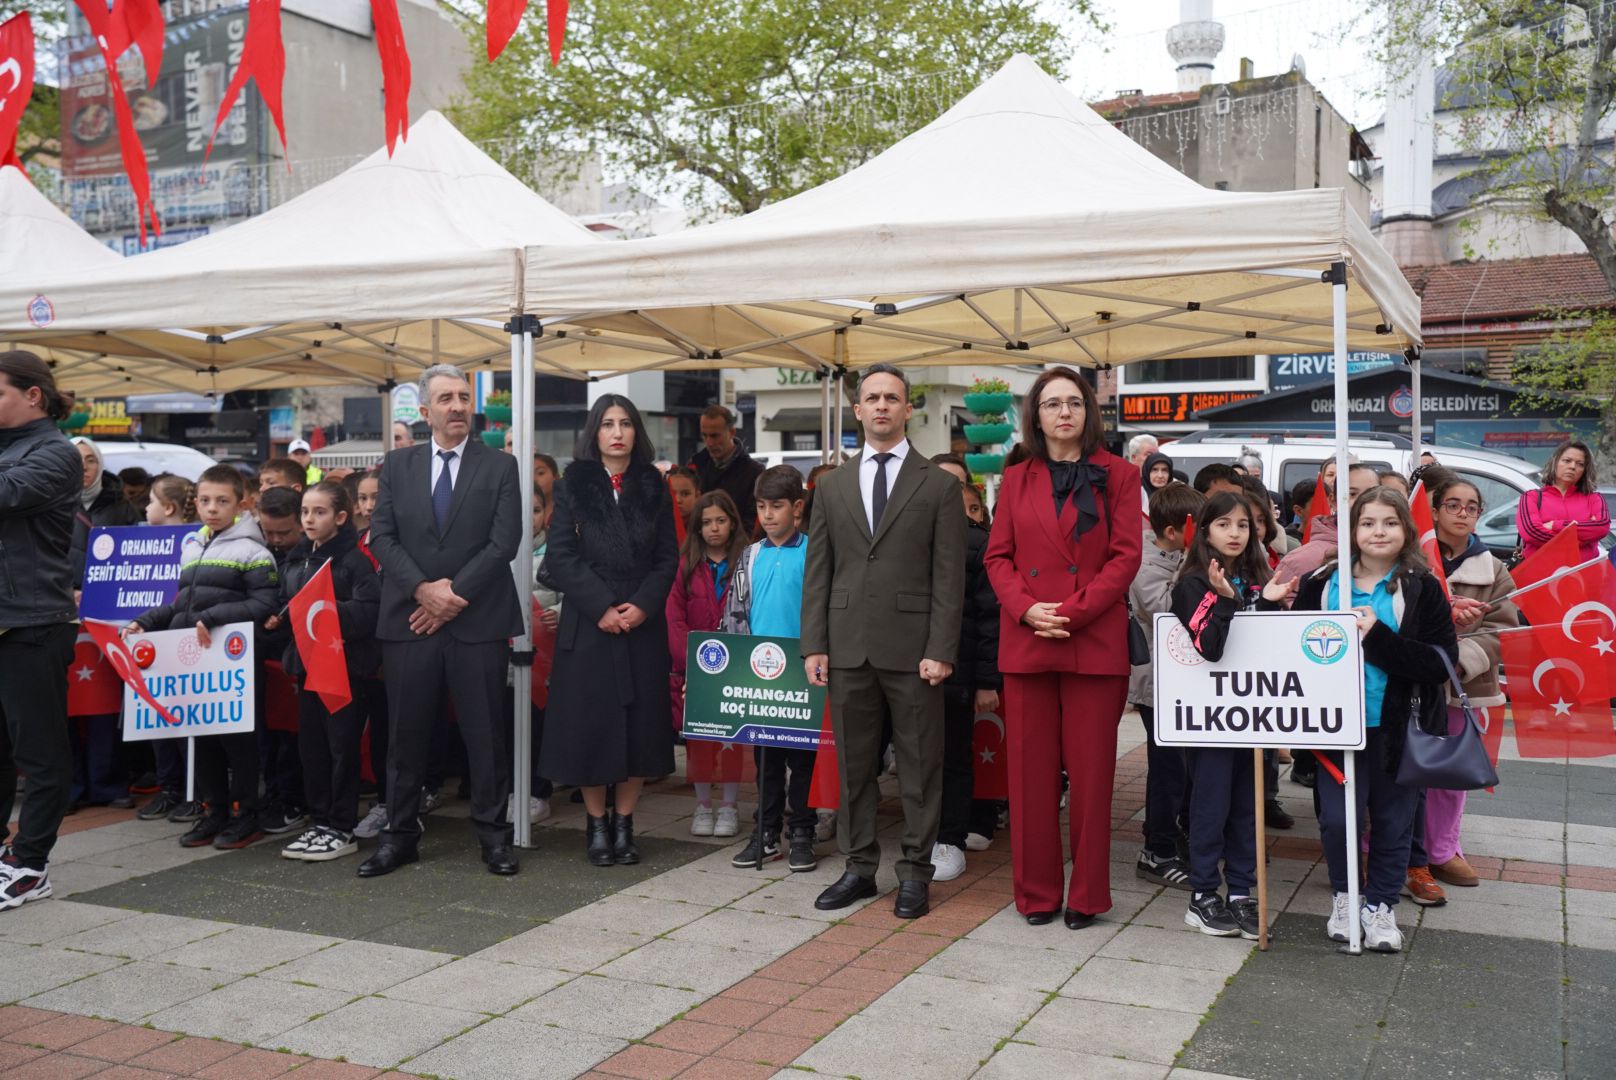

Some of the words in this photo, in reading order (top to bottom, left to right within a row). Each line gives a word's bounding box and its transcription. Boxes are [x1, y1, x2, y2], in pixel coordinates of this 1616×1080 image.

[184, 51, 203, 151] NEVER
[1277, 353, 1335, 375] ZİRVE
[1347, 352, 1391, 362] LETİŞİM
[1311, 395, 1385, 413] ORHNGAZİ
[1421, 394, 1500, 412] BELEDİYESİ
[120, 535, 175, 556] ORHANGAZİ
[87, 561, 115, 583] ŞEHİT
[115, 560, 152, 582] BÜLENT
[116, 587, 163, 608] İLKOKULU
[722, 685, 809, 704] ORHANGAZİ
[1209, 671, 1304, 698] TUNA
[136, 700, 243, 730] İLKOKULU
[720, 701, 746, 718] KOÇ
[748, 700, 812, 721] İLKOKULU
[1175, 699, 1343, 733] İLKOKULU
